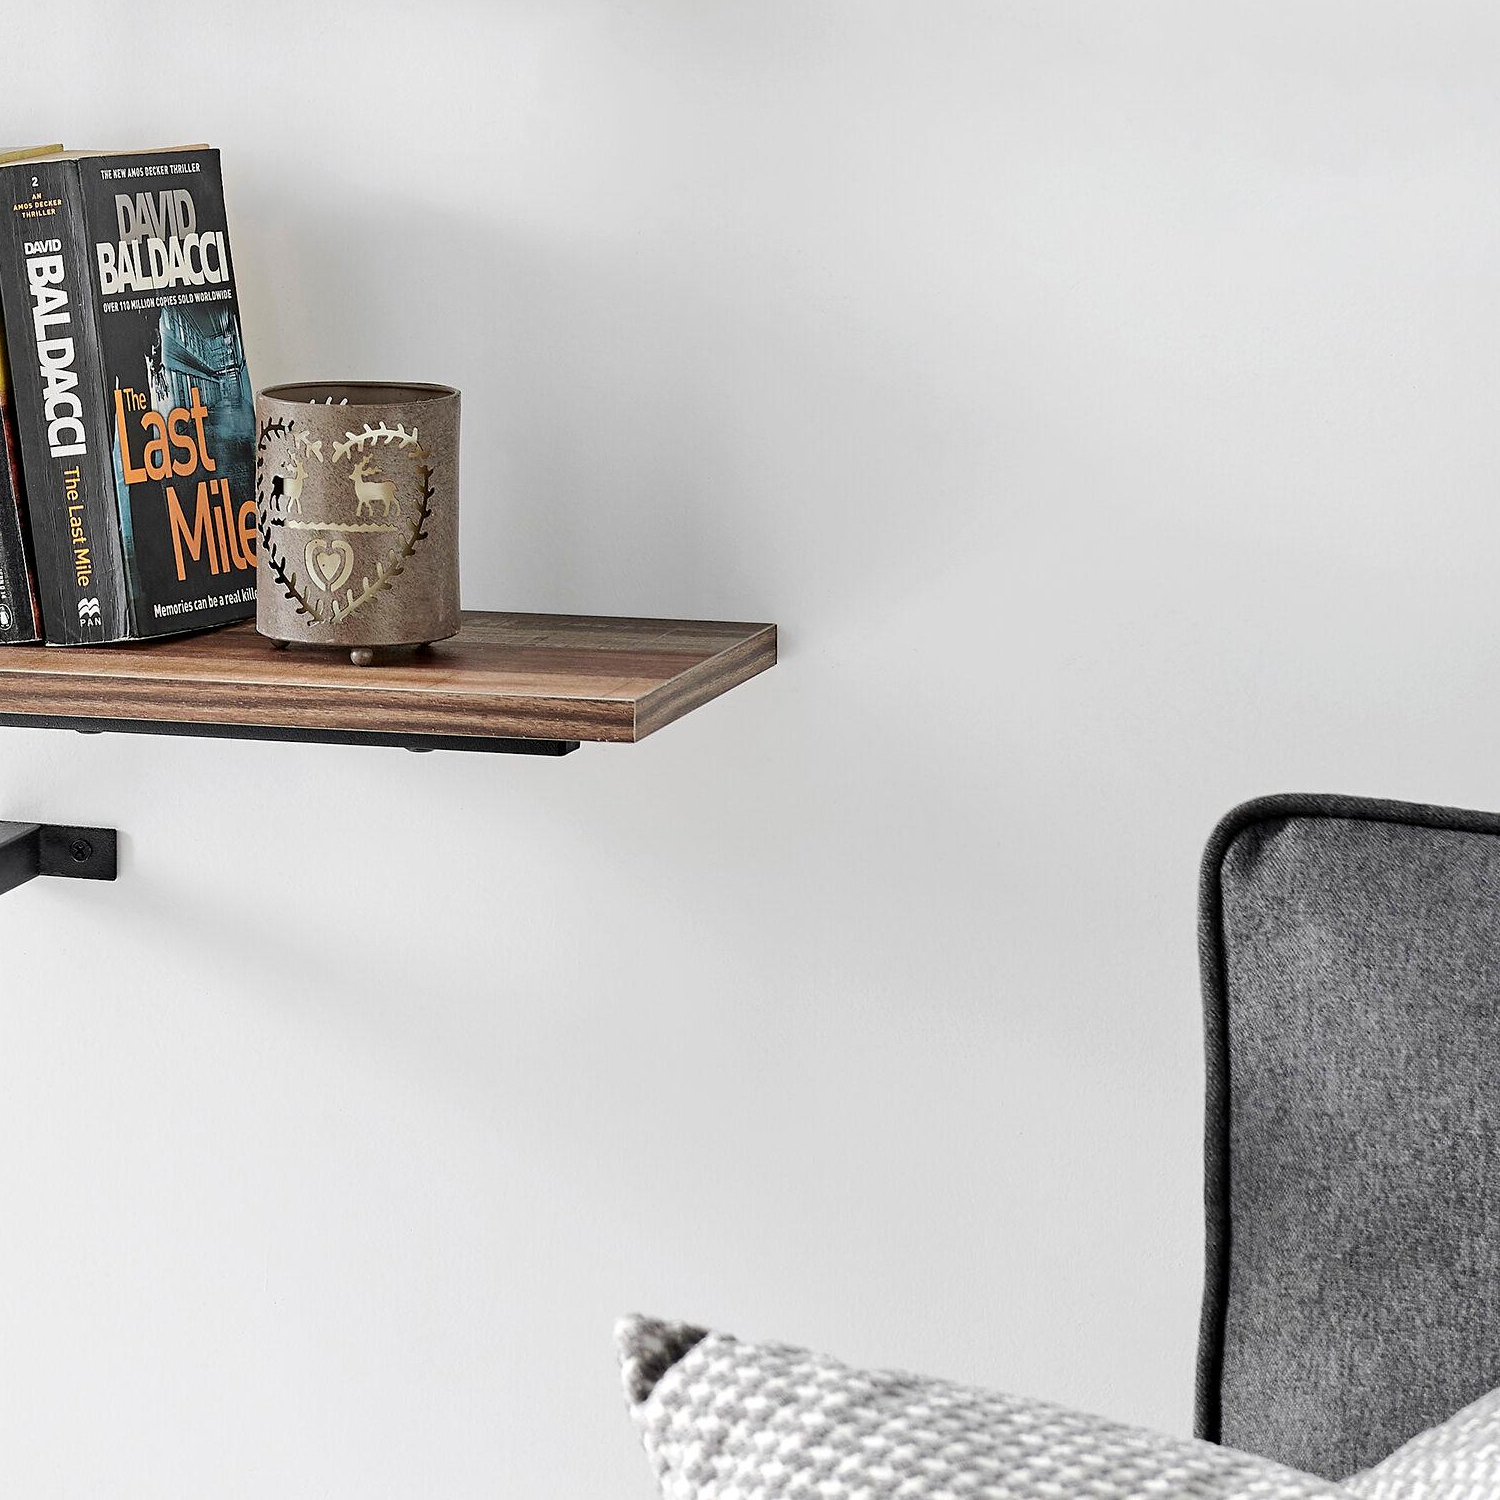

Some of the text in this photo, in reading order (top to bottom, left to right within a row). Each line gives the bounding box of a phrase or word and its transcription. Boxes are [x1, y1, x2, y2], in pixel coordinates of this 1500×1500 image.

[31, 176, 39, 187] 2
[100, 162, 201, 180] THE NEW AMOS DECKER THRILLER
[13, 199, 62, 211] AMOS DECKER
[31, 192, 42, 200] AN
[21, 208, 56, 218] THRILLER
[114, 189, 197, 245] DAVID
[23, 238, 62, 255] DAVID
[95, 231, 230, 296] BALDACCI
[102, 289, 232, 313] OVER 110 MILLION COPIES SOLD WORLDWIDE
[25, 254, 88, 458] BALDACCI
[123, 387, 147, 412] The
[114, 387, 216, 485] Last
[63, 465, 92, 587] The Last Mile
[166, 478, 258, 581] Mile
[153, 599, 193, 618] Memories
[194, 598, 208, 611] can
[207, 594, 219, 608] be
[219, 595, 225, 606] a
[224, 589, 241, 605] real
[80, 617, 101, 627] PAN
